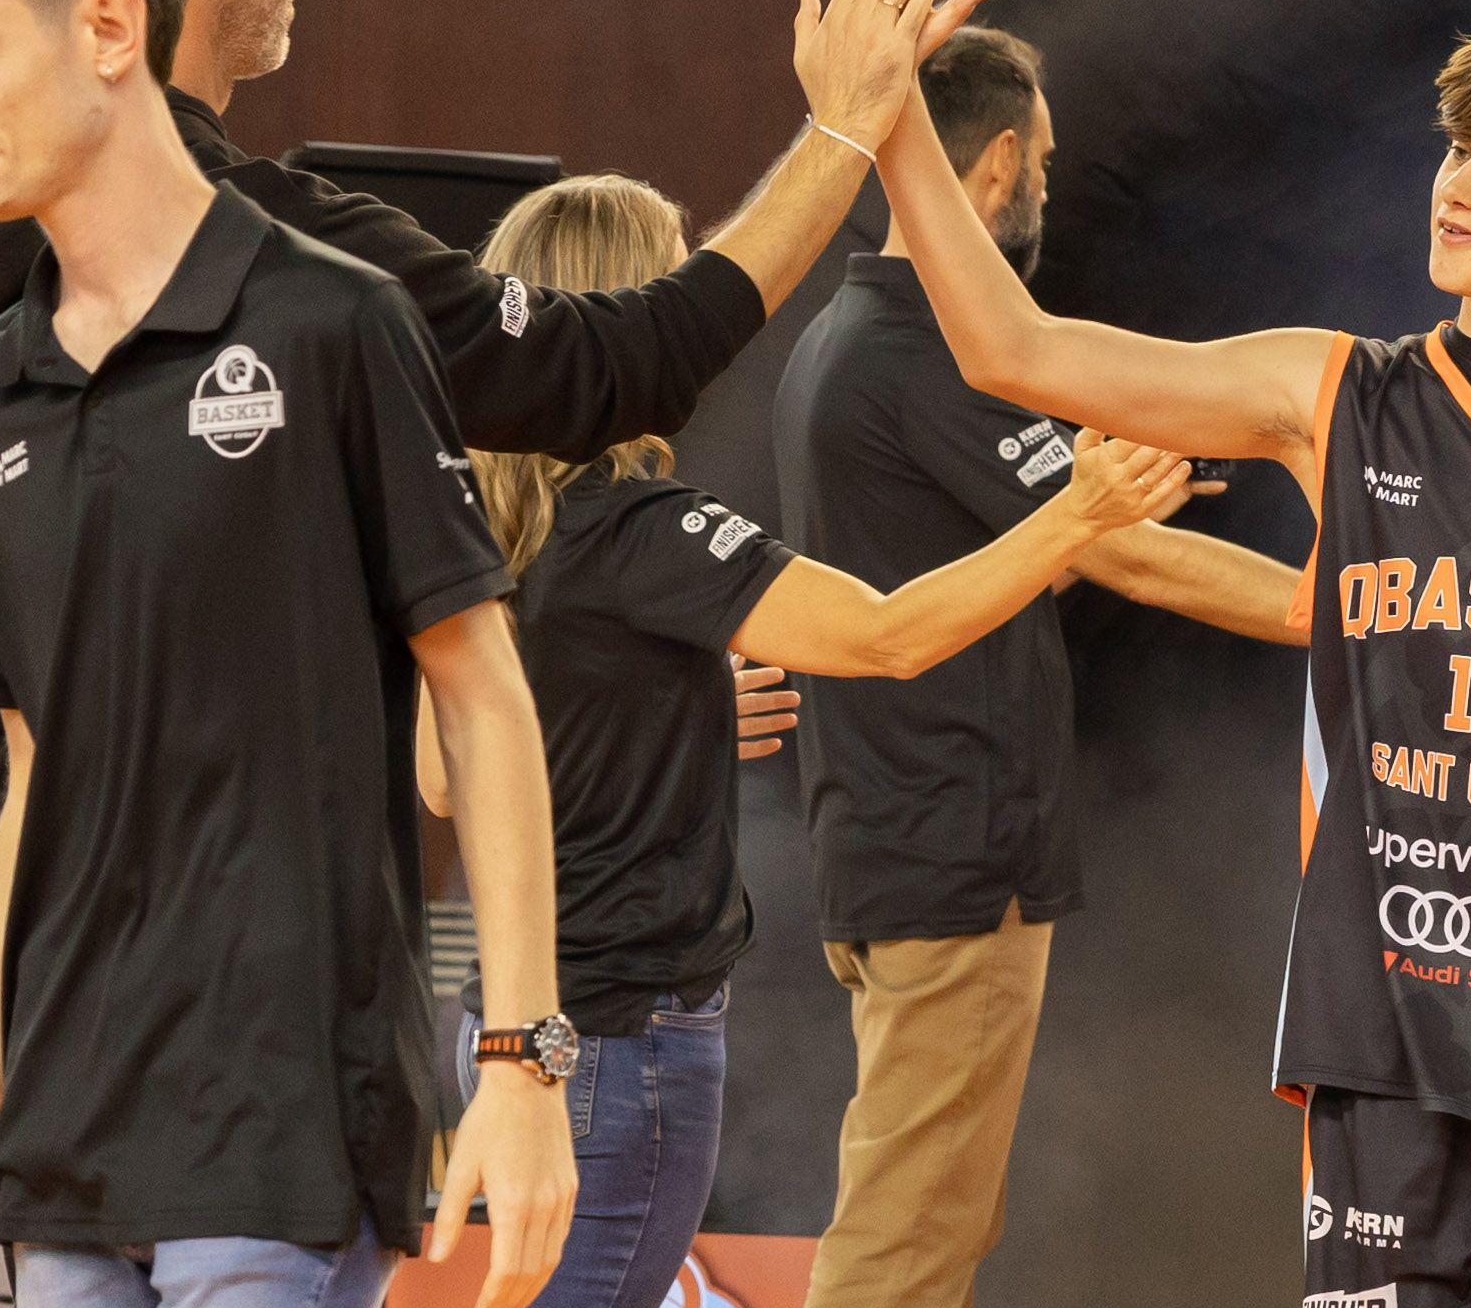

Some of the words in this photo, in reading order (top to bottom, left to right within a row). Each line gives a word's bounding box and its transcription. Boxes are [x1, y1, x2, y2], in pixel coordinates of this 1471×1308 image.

[197, 400, 274, 424] BASKET
[1379, 471, 1423, 490] MARC
[1376, 486, 1420, 507] MART
[1371, 742, 1456, 800] SANT
[1399, 956, 1460, 985] Audi
